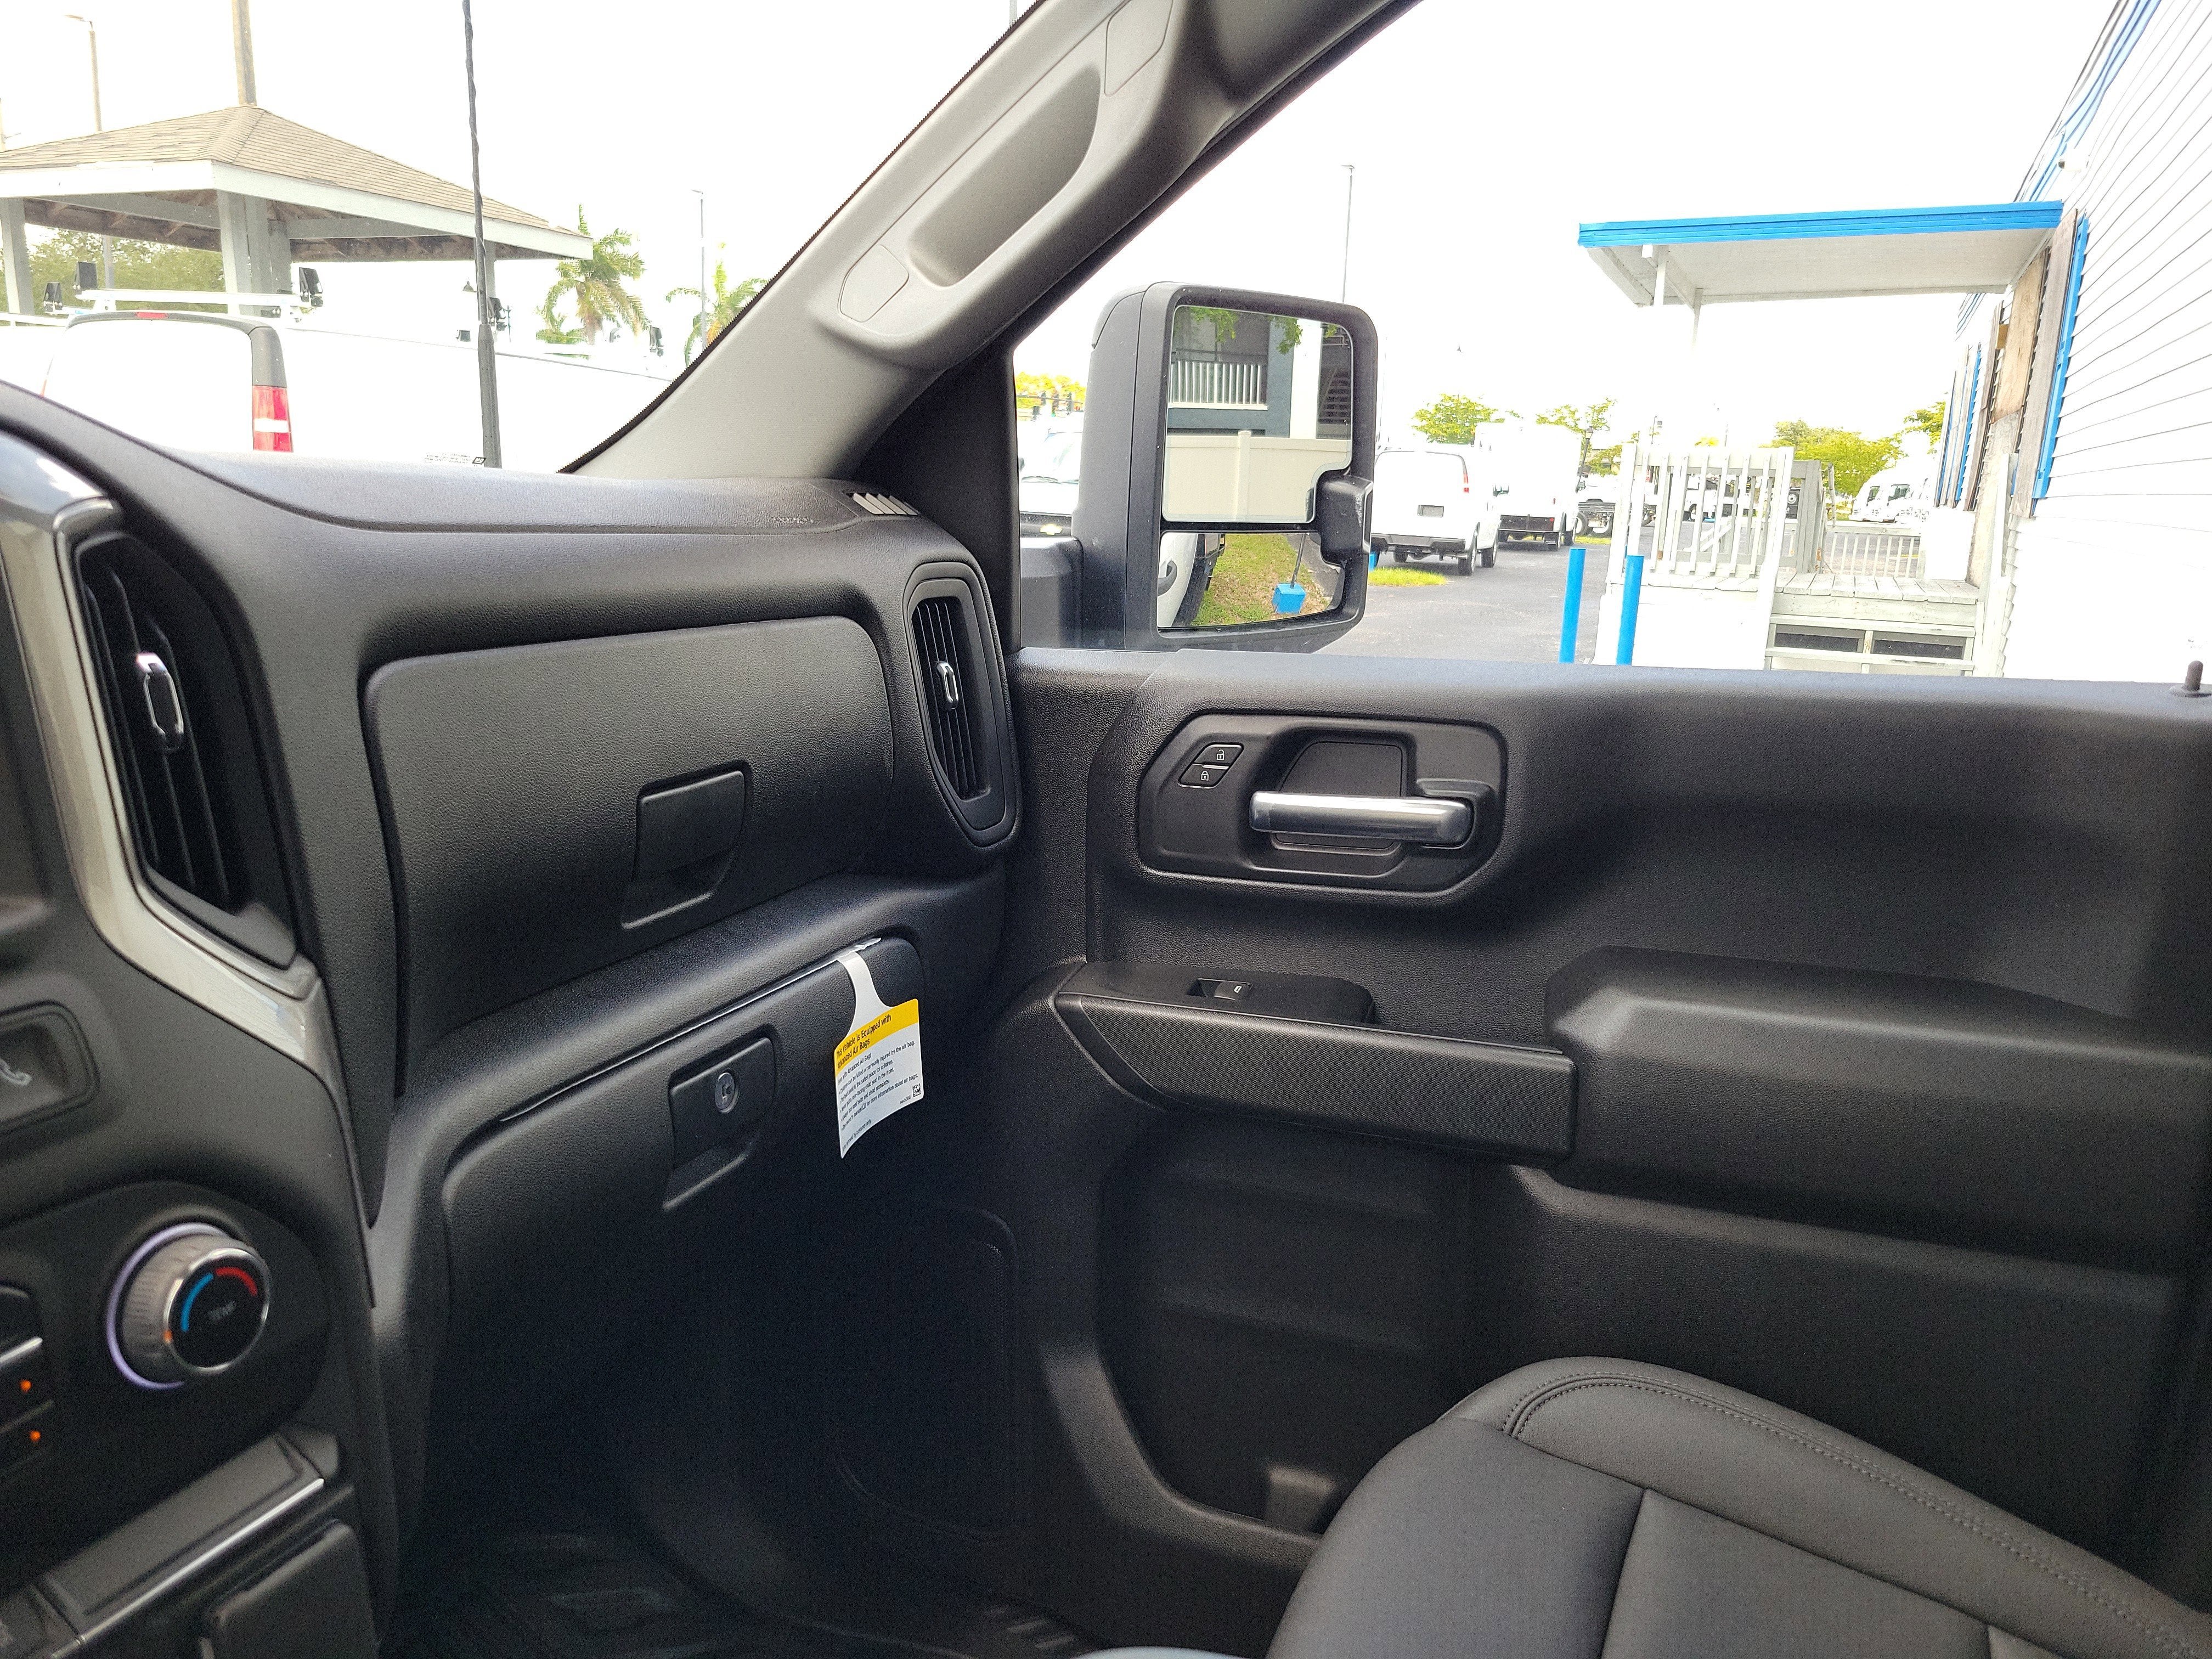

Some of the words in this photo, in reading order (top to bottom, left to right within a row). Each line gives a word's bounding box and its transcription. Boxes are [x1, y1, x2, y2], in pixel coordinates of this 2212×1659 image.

[843, 1037, 856, 1052] Vehicle
[856, 1034, 860, 1042] Is
[861, 1019, 881, 1038] Equipped
[881, 1014, 891, 1025] with
[838, 1049, 852, 1071] Advanced
[860, 1039, 870, 1050] Bags
[867, 1058, 880, 1069] seriously
[880, 1051, 891, 1062] injured
[848, 1060, 860, 1074] Advanced
[881, 1060, 894, 1070] children.
[878, 1086, 894, 1098] information
[895, 1080, 904, 1088] about
